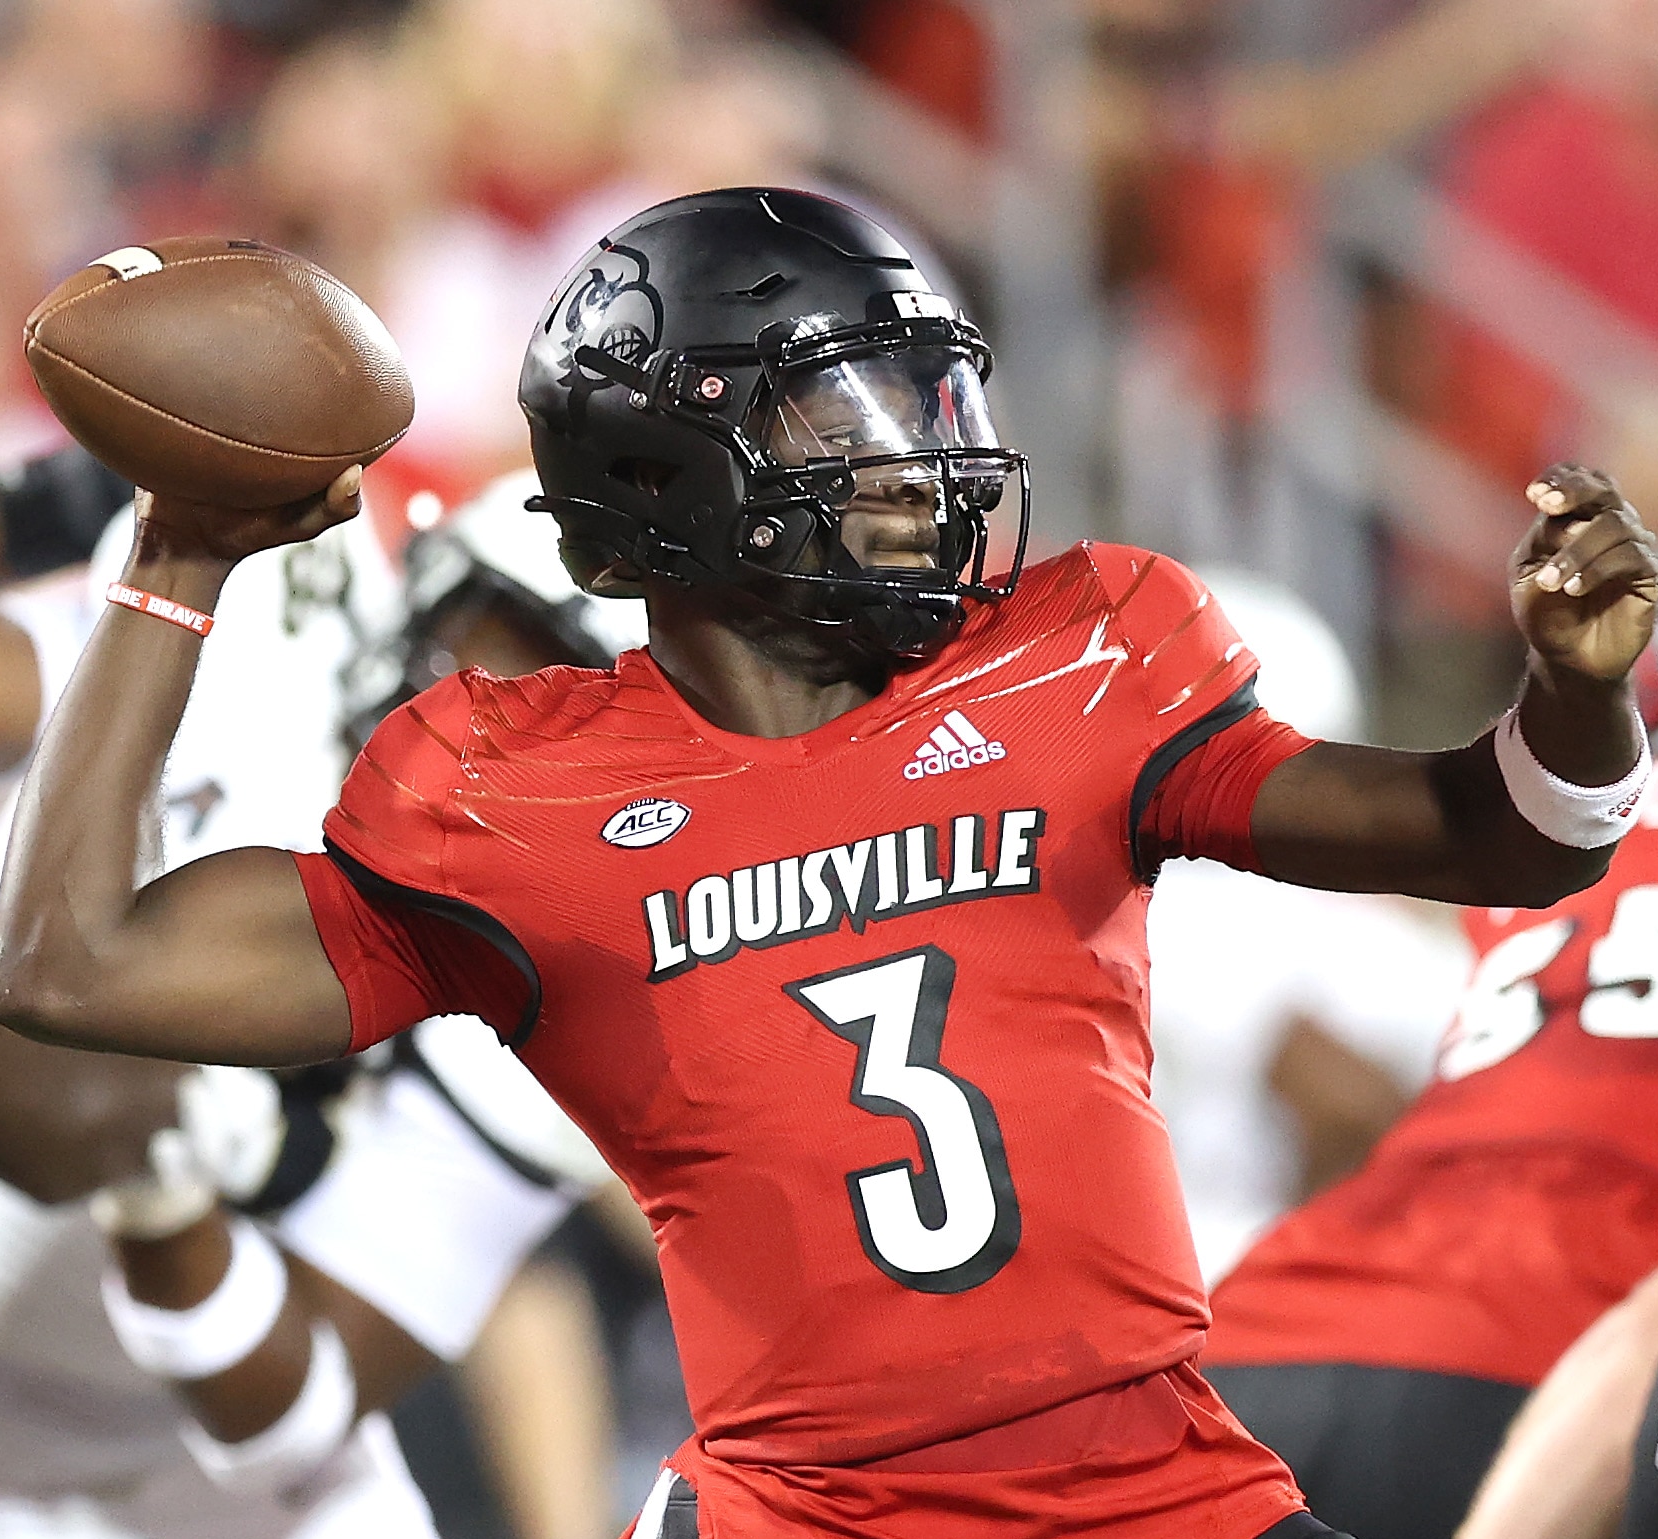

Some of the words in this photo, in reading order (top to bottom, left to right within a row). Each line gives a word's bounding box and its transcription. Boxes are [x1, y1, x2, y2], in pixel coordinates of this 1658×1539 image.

[145, 596, 206, 631] BRAVE
[903, 741, 1007, 780] adidas
[614, 804, 674, 835] ACC
[645, 808, 1046, 983] LOUISVILLE
[781, 943, 1021, 1294] 3
